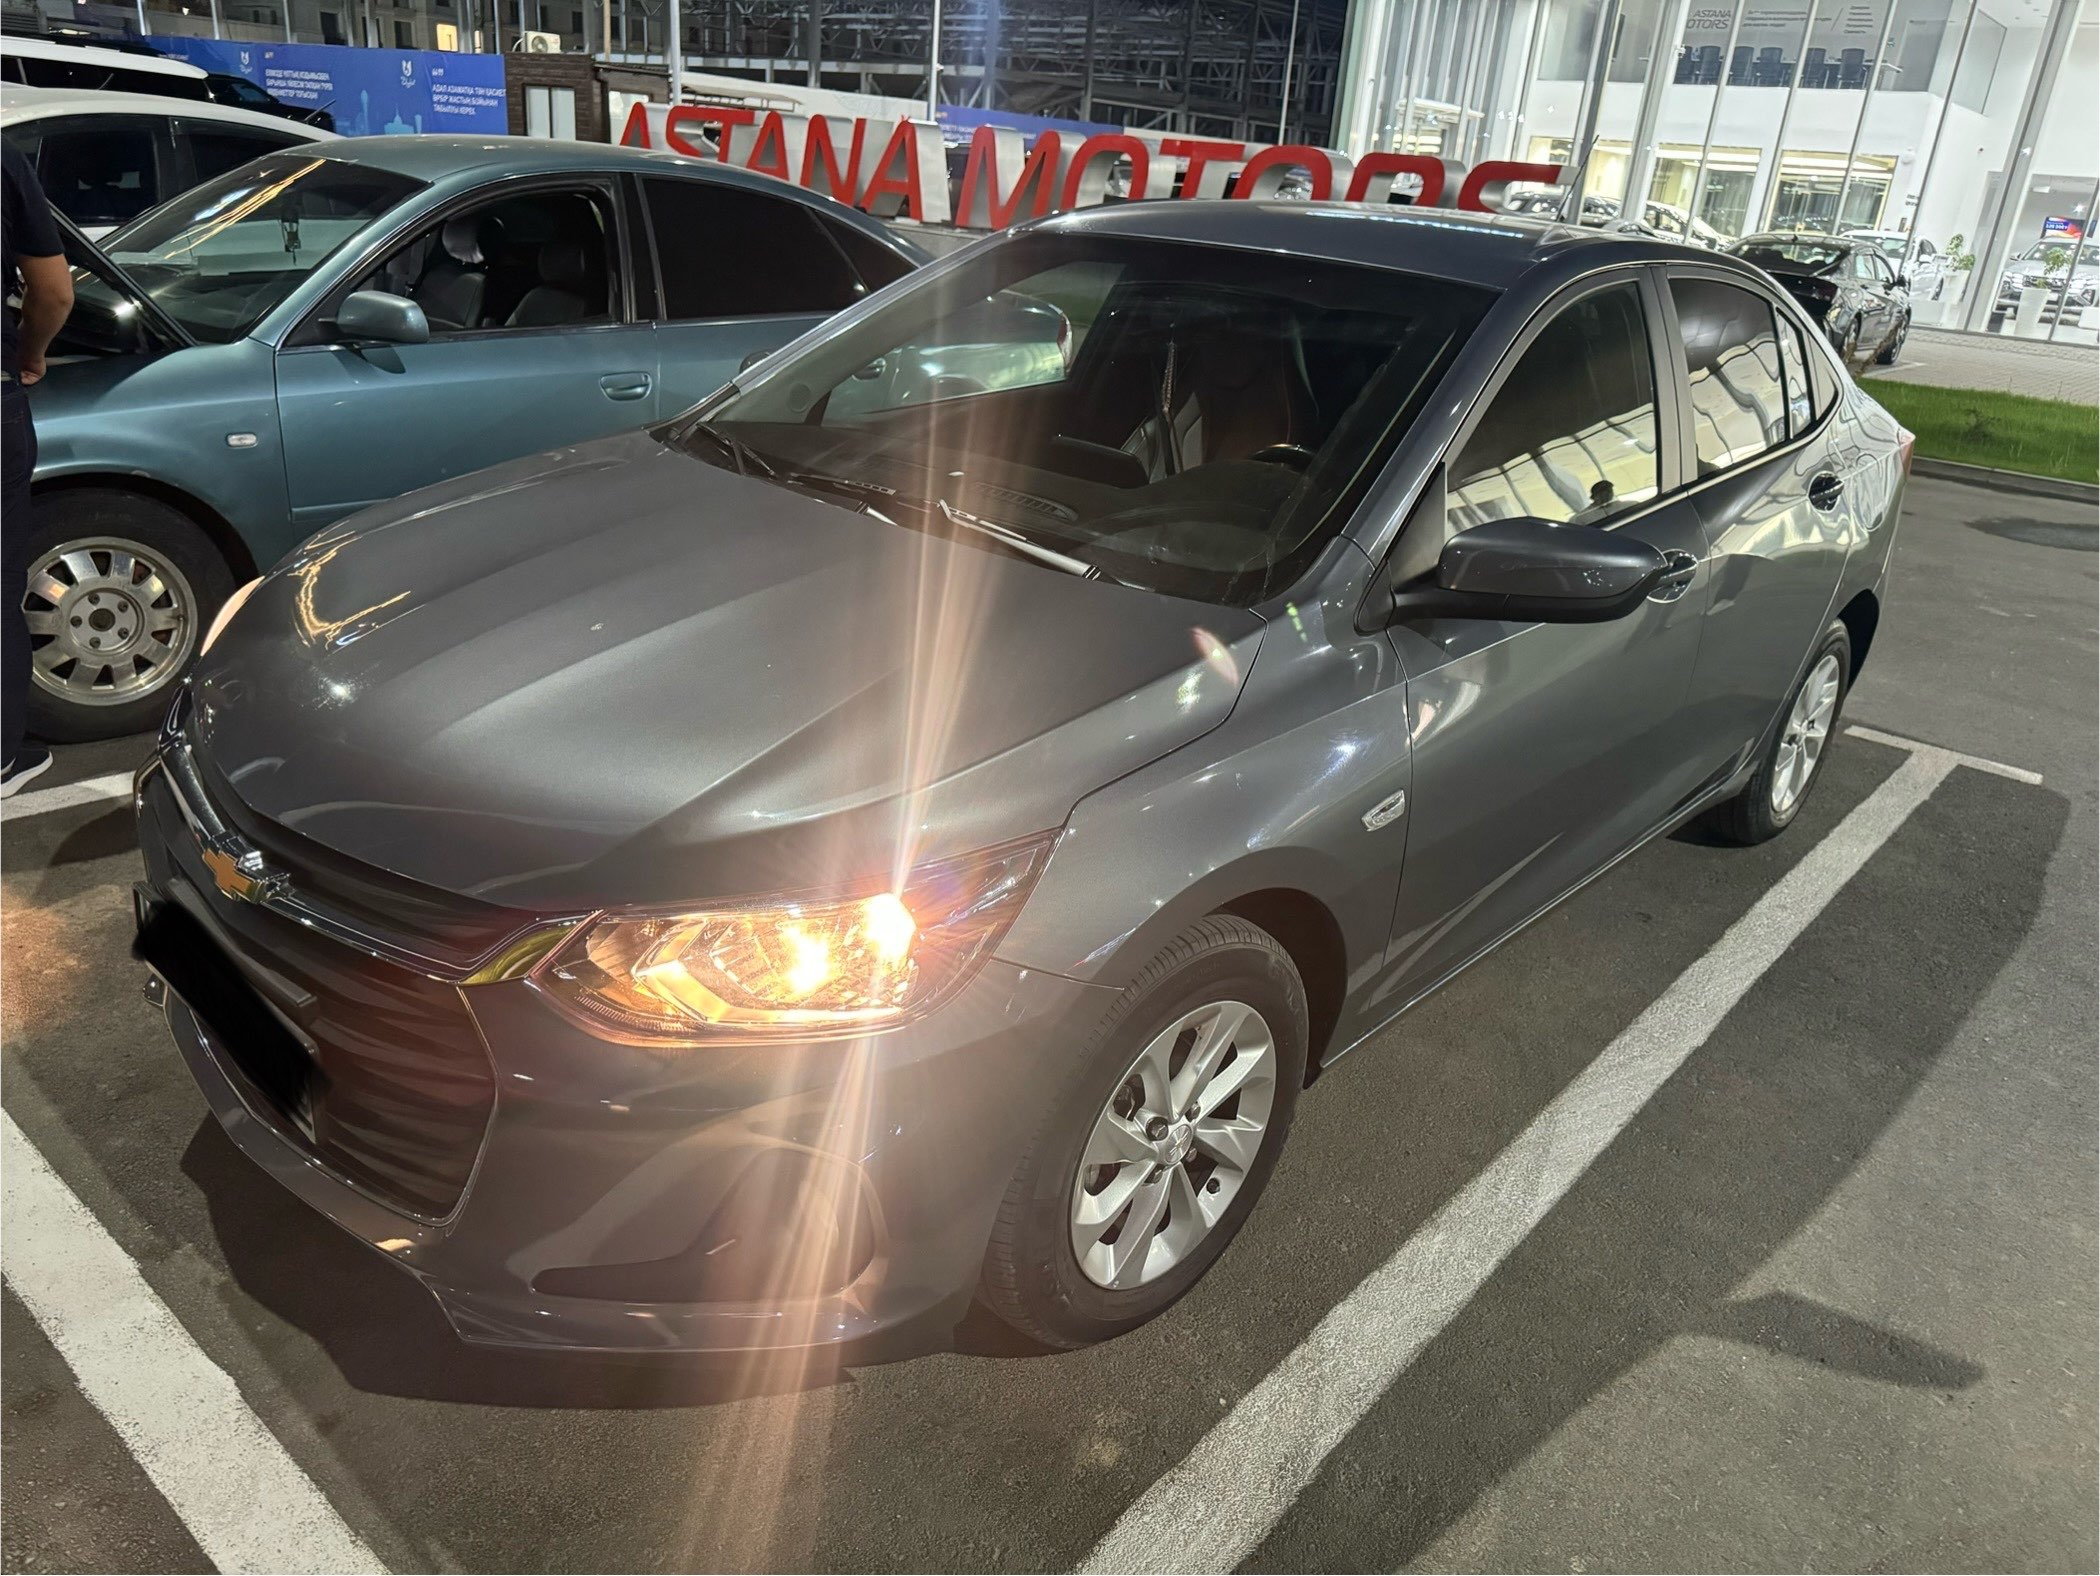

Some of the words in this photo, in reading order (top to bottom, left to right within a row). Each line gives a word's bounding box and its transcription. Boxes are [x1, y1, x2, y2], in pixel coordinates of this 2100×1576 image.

[1694, 9, 1732, 18] ASTANA
[1686, 18, 1730, 30] OTORS
[619, 101, 924, 221] ASTANA
[955, 125, 1565, 230] MOTORS
